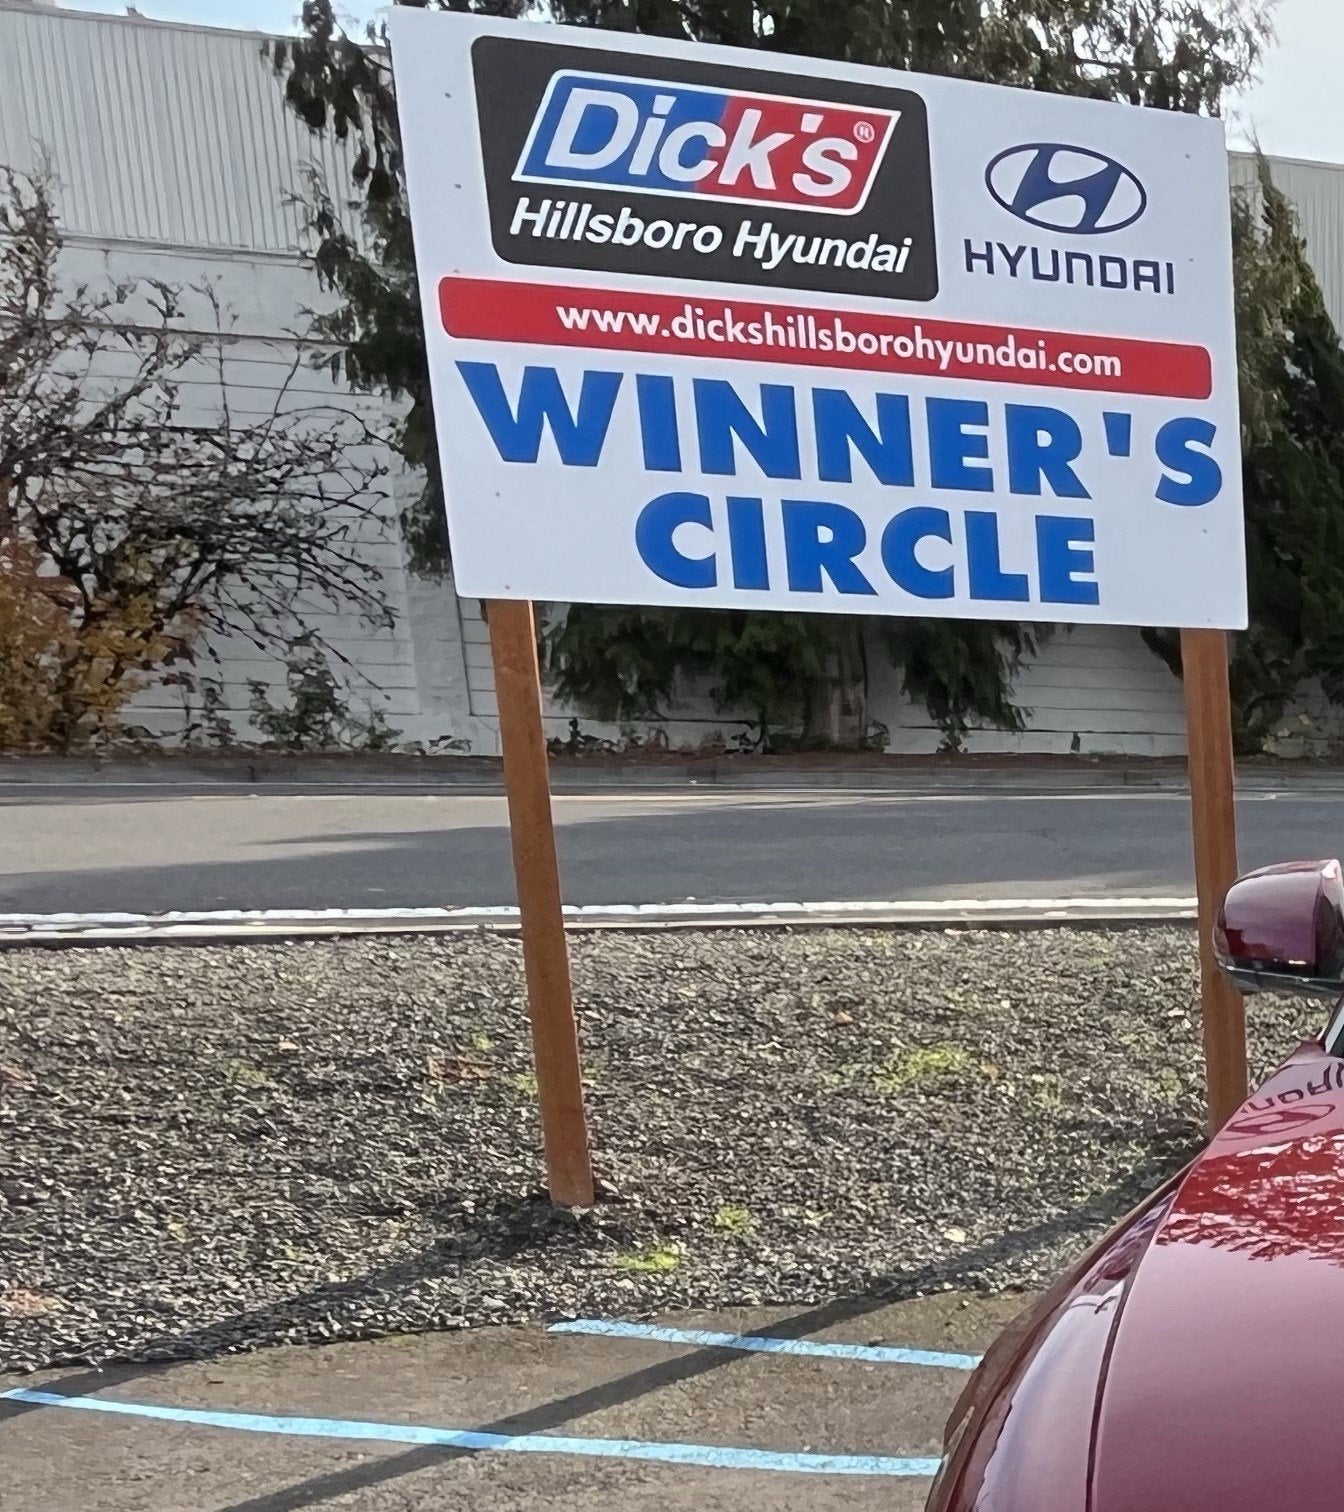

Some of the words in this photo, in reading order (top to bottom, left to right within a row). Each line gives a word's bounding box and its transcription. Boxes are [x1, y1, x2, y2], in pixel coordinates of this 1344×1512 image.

[544, 86, 858, 198] Dick's
[508, 197, 722, 255] Hillsboro
[731, 221, 914, 275] Hyundai
[964, 238, 1174, 295] HYUNDAI
[556, 303, 1122, 379] www.dickshillsborohyundai.com
[455, 361, 1223, 507] WINNER'S
[635, 491, 1100, 605] CIRCLE
